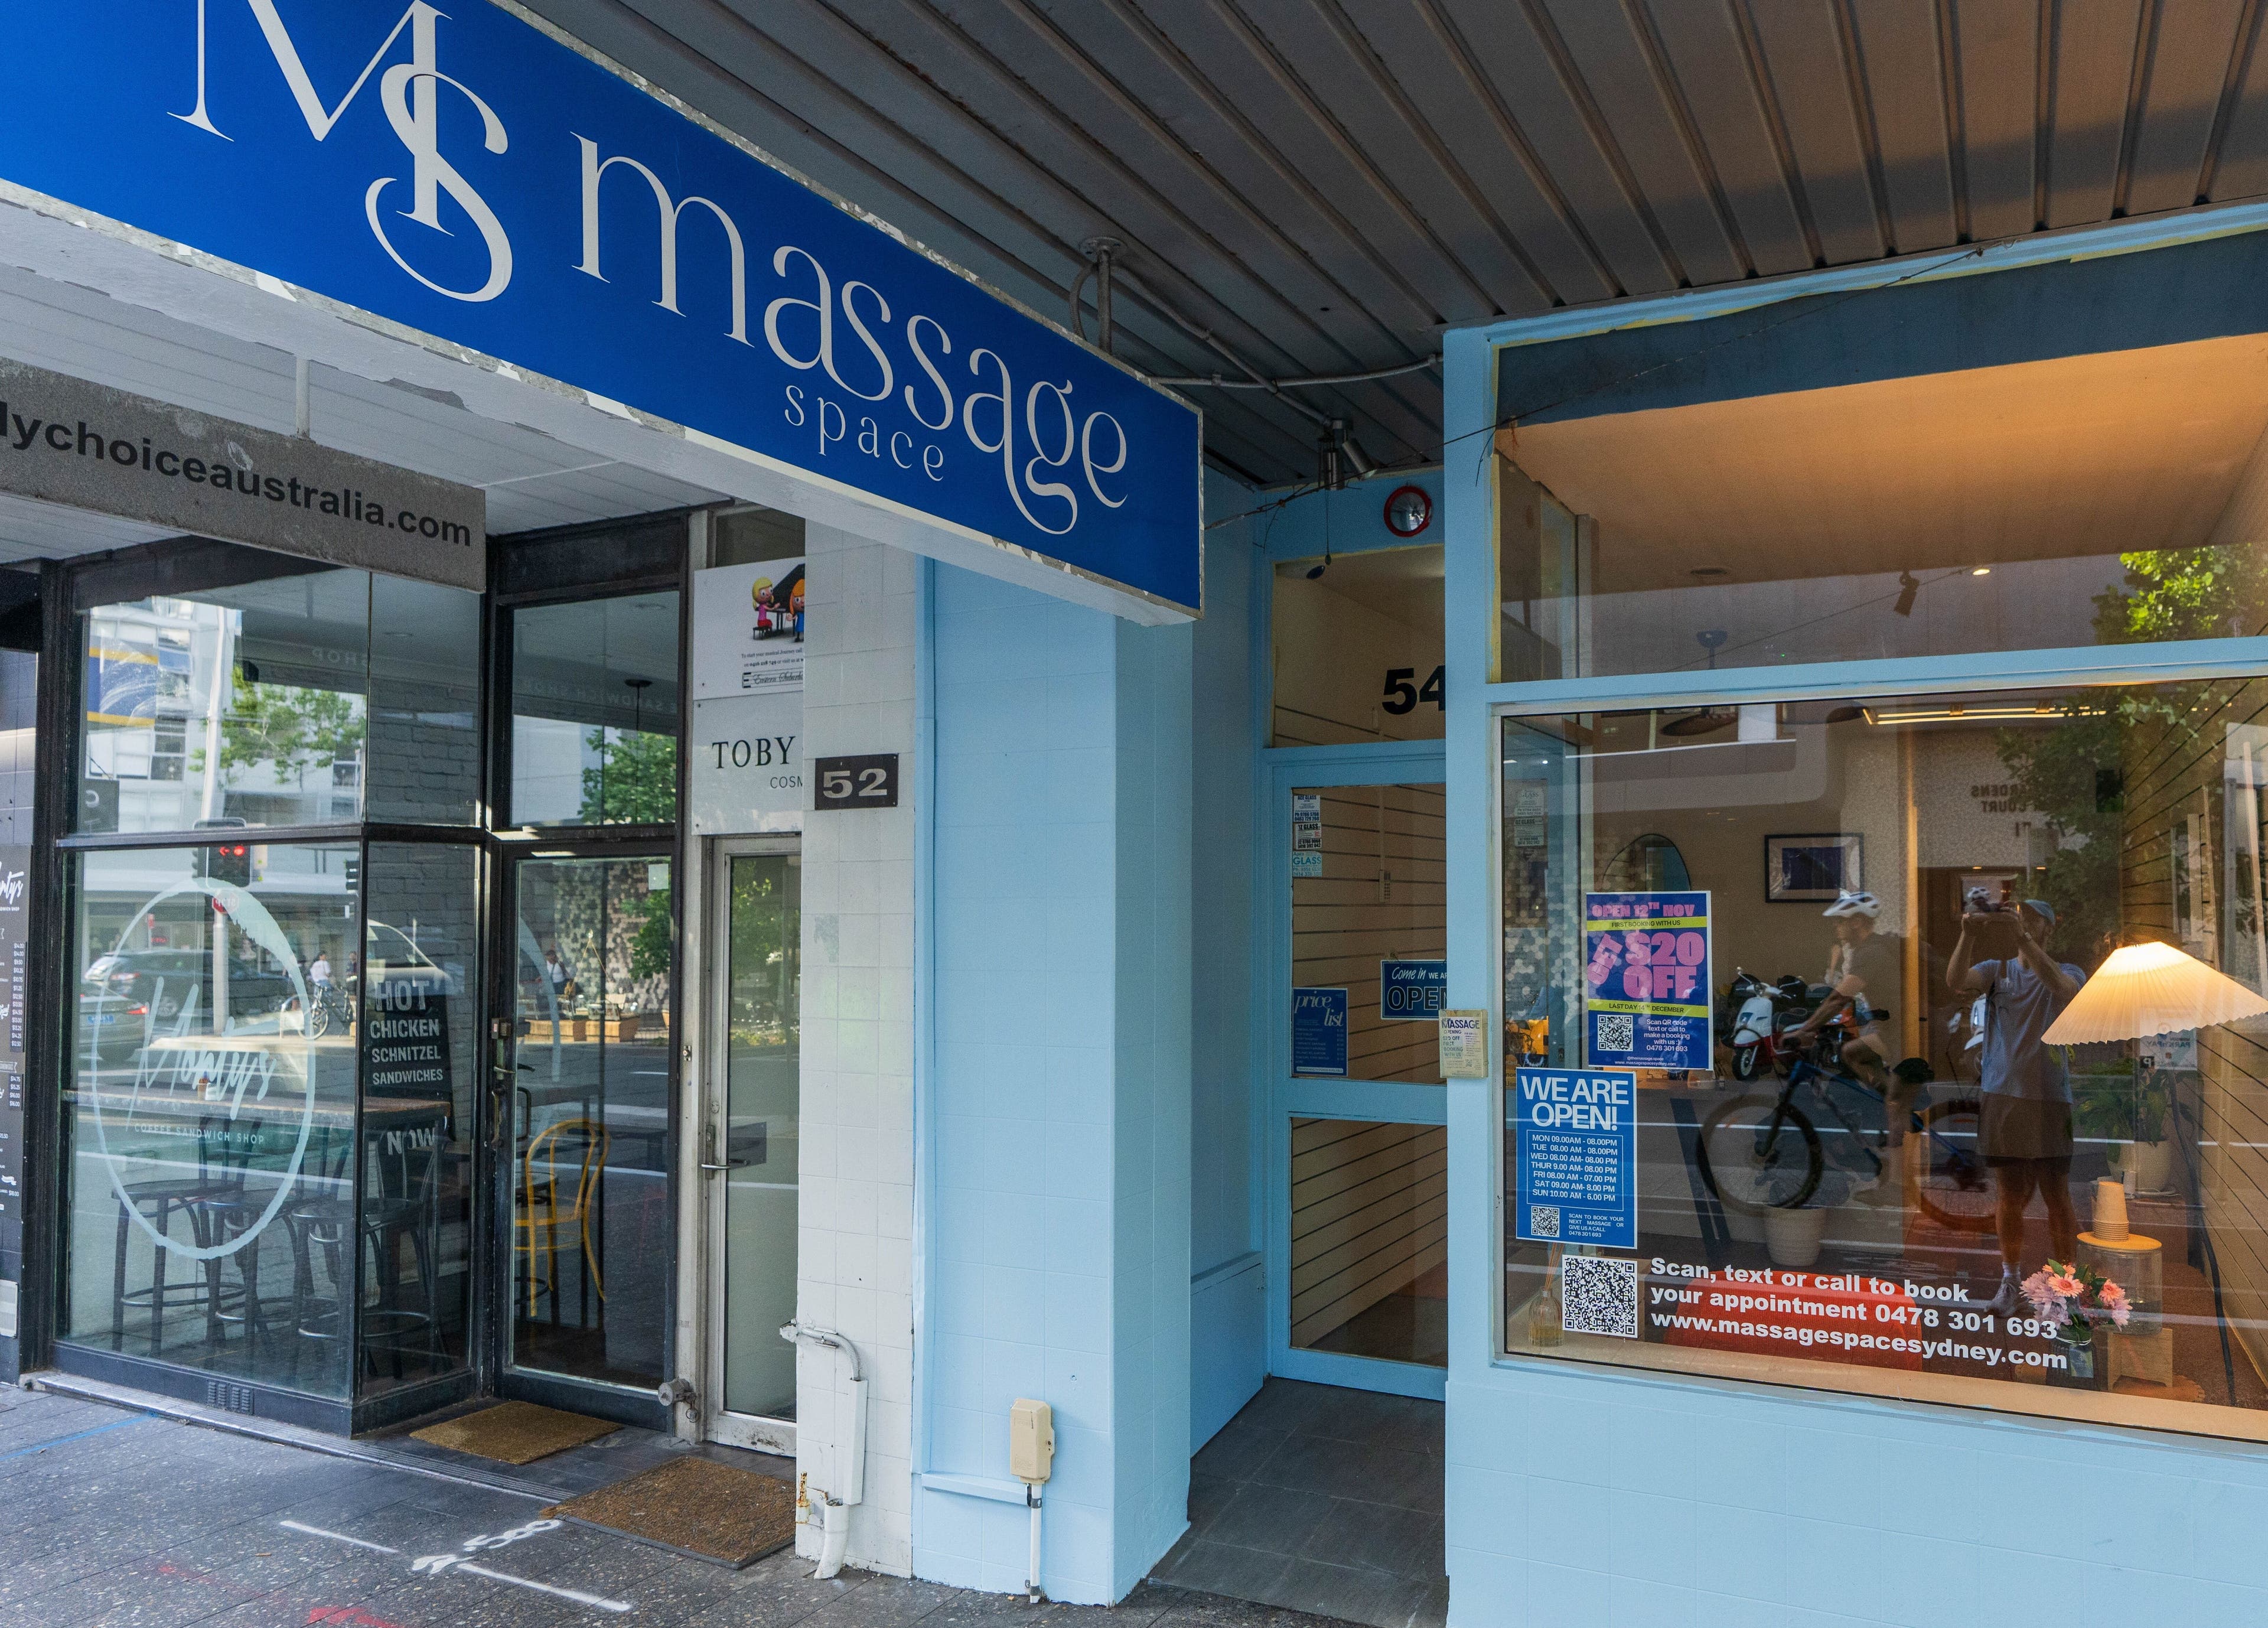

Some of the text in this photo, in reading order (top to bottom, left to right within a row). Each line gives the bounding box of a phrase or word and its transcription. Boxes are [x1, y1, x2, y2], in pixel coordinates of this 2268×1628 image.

[571, 131, 1128, 536] massage
[784, 384, 946, 483] space
[1381, 665, 1446, 715] 54
[712, 735, 796, 769] TOBY
[823, 768, 888, 798] 52
[1293, 857, 1322, 865] GLASS
[1592, 904, 1631, 917] OPEN
[1663, 904, 1695, 917] NOV
[1625, 929, 1705, 966] $20
[1586, 933, 1623, 985] GET
[1392, 966, 1417, 980] Come
[1418, 967, 1426, 980] in
[1623, 965, 1697, 999] OFF
[374, 980, 430, 1012] HOT
[1294, 990, 1332, 1014] price
[1324, 1008, 1344, 1027] list
[1442, 1020, 1480, 1029] MASSAGE
[370, 1018, 440, 1039] CHICKEN
[372, 1045, 441, 1063] SCHNITZEL
[372, 1069, 444, 1086] SANDWICHES
[1521, 1076, 1630, 1105] WE ARE
[1531, 1102, 1618, 1132] OPEN!
[134, 1124, 265, 1145] COFFEE SANDWICH SHOP
[1551, 1135, 1581, 1144] 09.00AM
[1586, 1138, 1618, 1147] 08.00PM
[1530, 1152, 1549, 1160] WED
[1585, 1156, 1604, 1164] 08.00
[1550, 1144, 1569, 1152] 08.00
[1587, 1147, 1618, 1156] 08.00PM
[1531, 1161, 1552, 1170] THUR
[1546, 1171, 1565, 1180] 08.00
[1583, 1174, 1603, 1183] 07.00
[1551, 1181, 1570, 1189] 09.00
[1586, 1184, 1602, 1192] 8.00
[1532, 1189, 1549, 1197] SUN
[1550, 1190, 1568, 1198] 10.00
[1650, 1257, 1970, 1303] Scan, text or call to book
[1650, 1287, 2058, 1340] your appointment 0478 301 693
[1650, 1313, 2068, 1369] www.massagespacesydney.com
